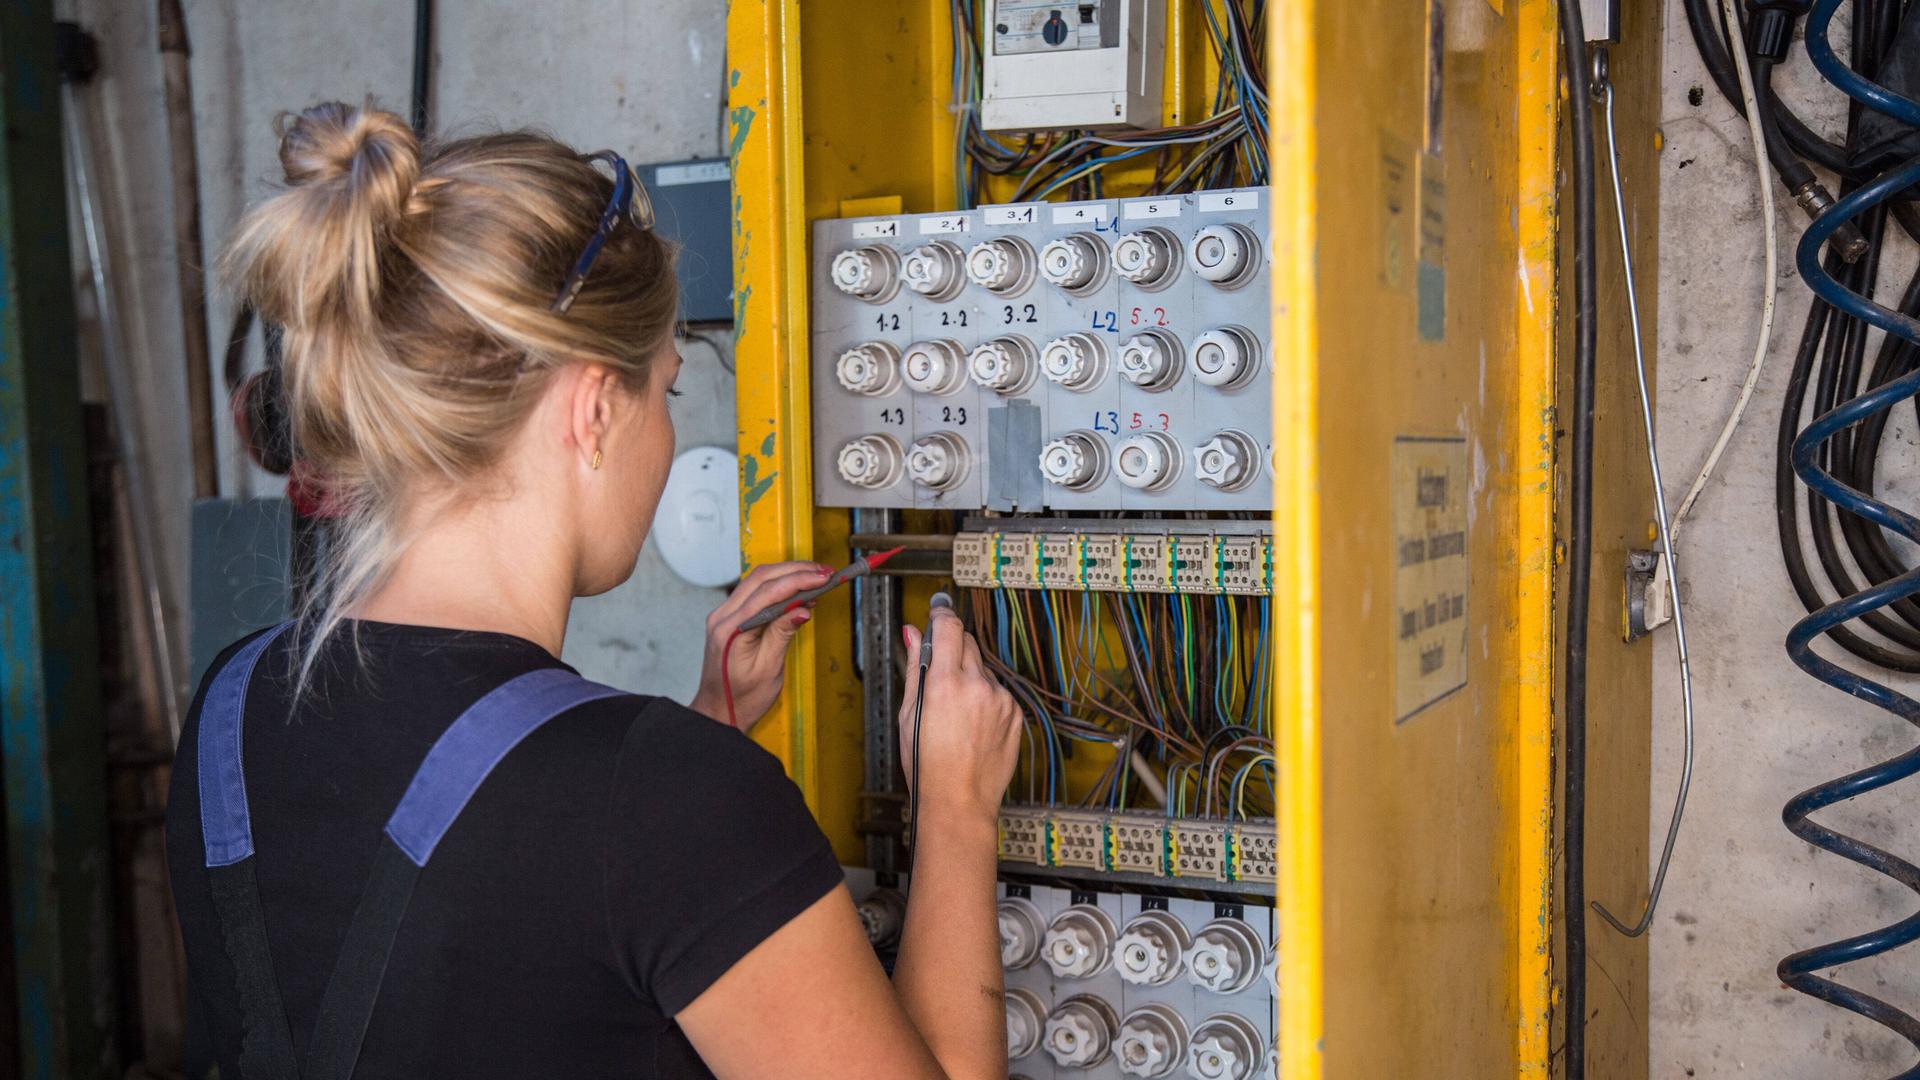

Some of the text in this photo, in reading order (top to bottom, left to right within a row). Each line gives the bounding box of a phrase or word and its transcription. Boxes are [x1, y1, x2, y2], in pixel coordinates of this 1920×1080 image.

[1148, 205, 1158, 213] 5
[1224, 197, 1234, 206] 6
[1007, 207, 1032, 222] 3.1
[1095, 216, 1119, 233] L1
[876, 313, 900, 332] 1.2
[941, 310, 968, 327] 2.2
[1004, 304, 1038, 325] 3.2
[1092, 310, 1119, 333] L2
[880, 408, 904, 425] 1.3
[942, 406, 967, 425] 2.3
[1094, 411, 1119, 435] L3
[1130, 412, 1169, 431] 5.3
